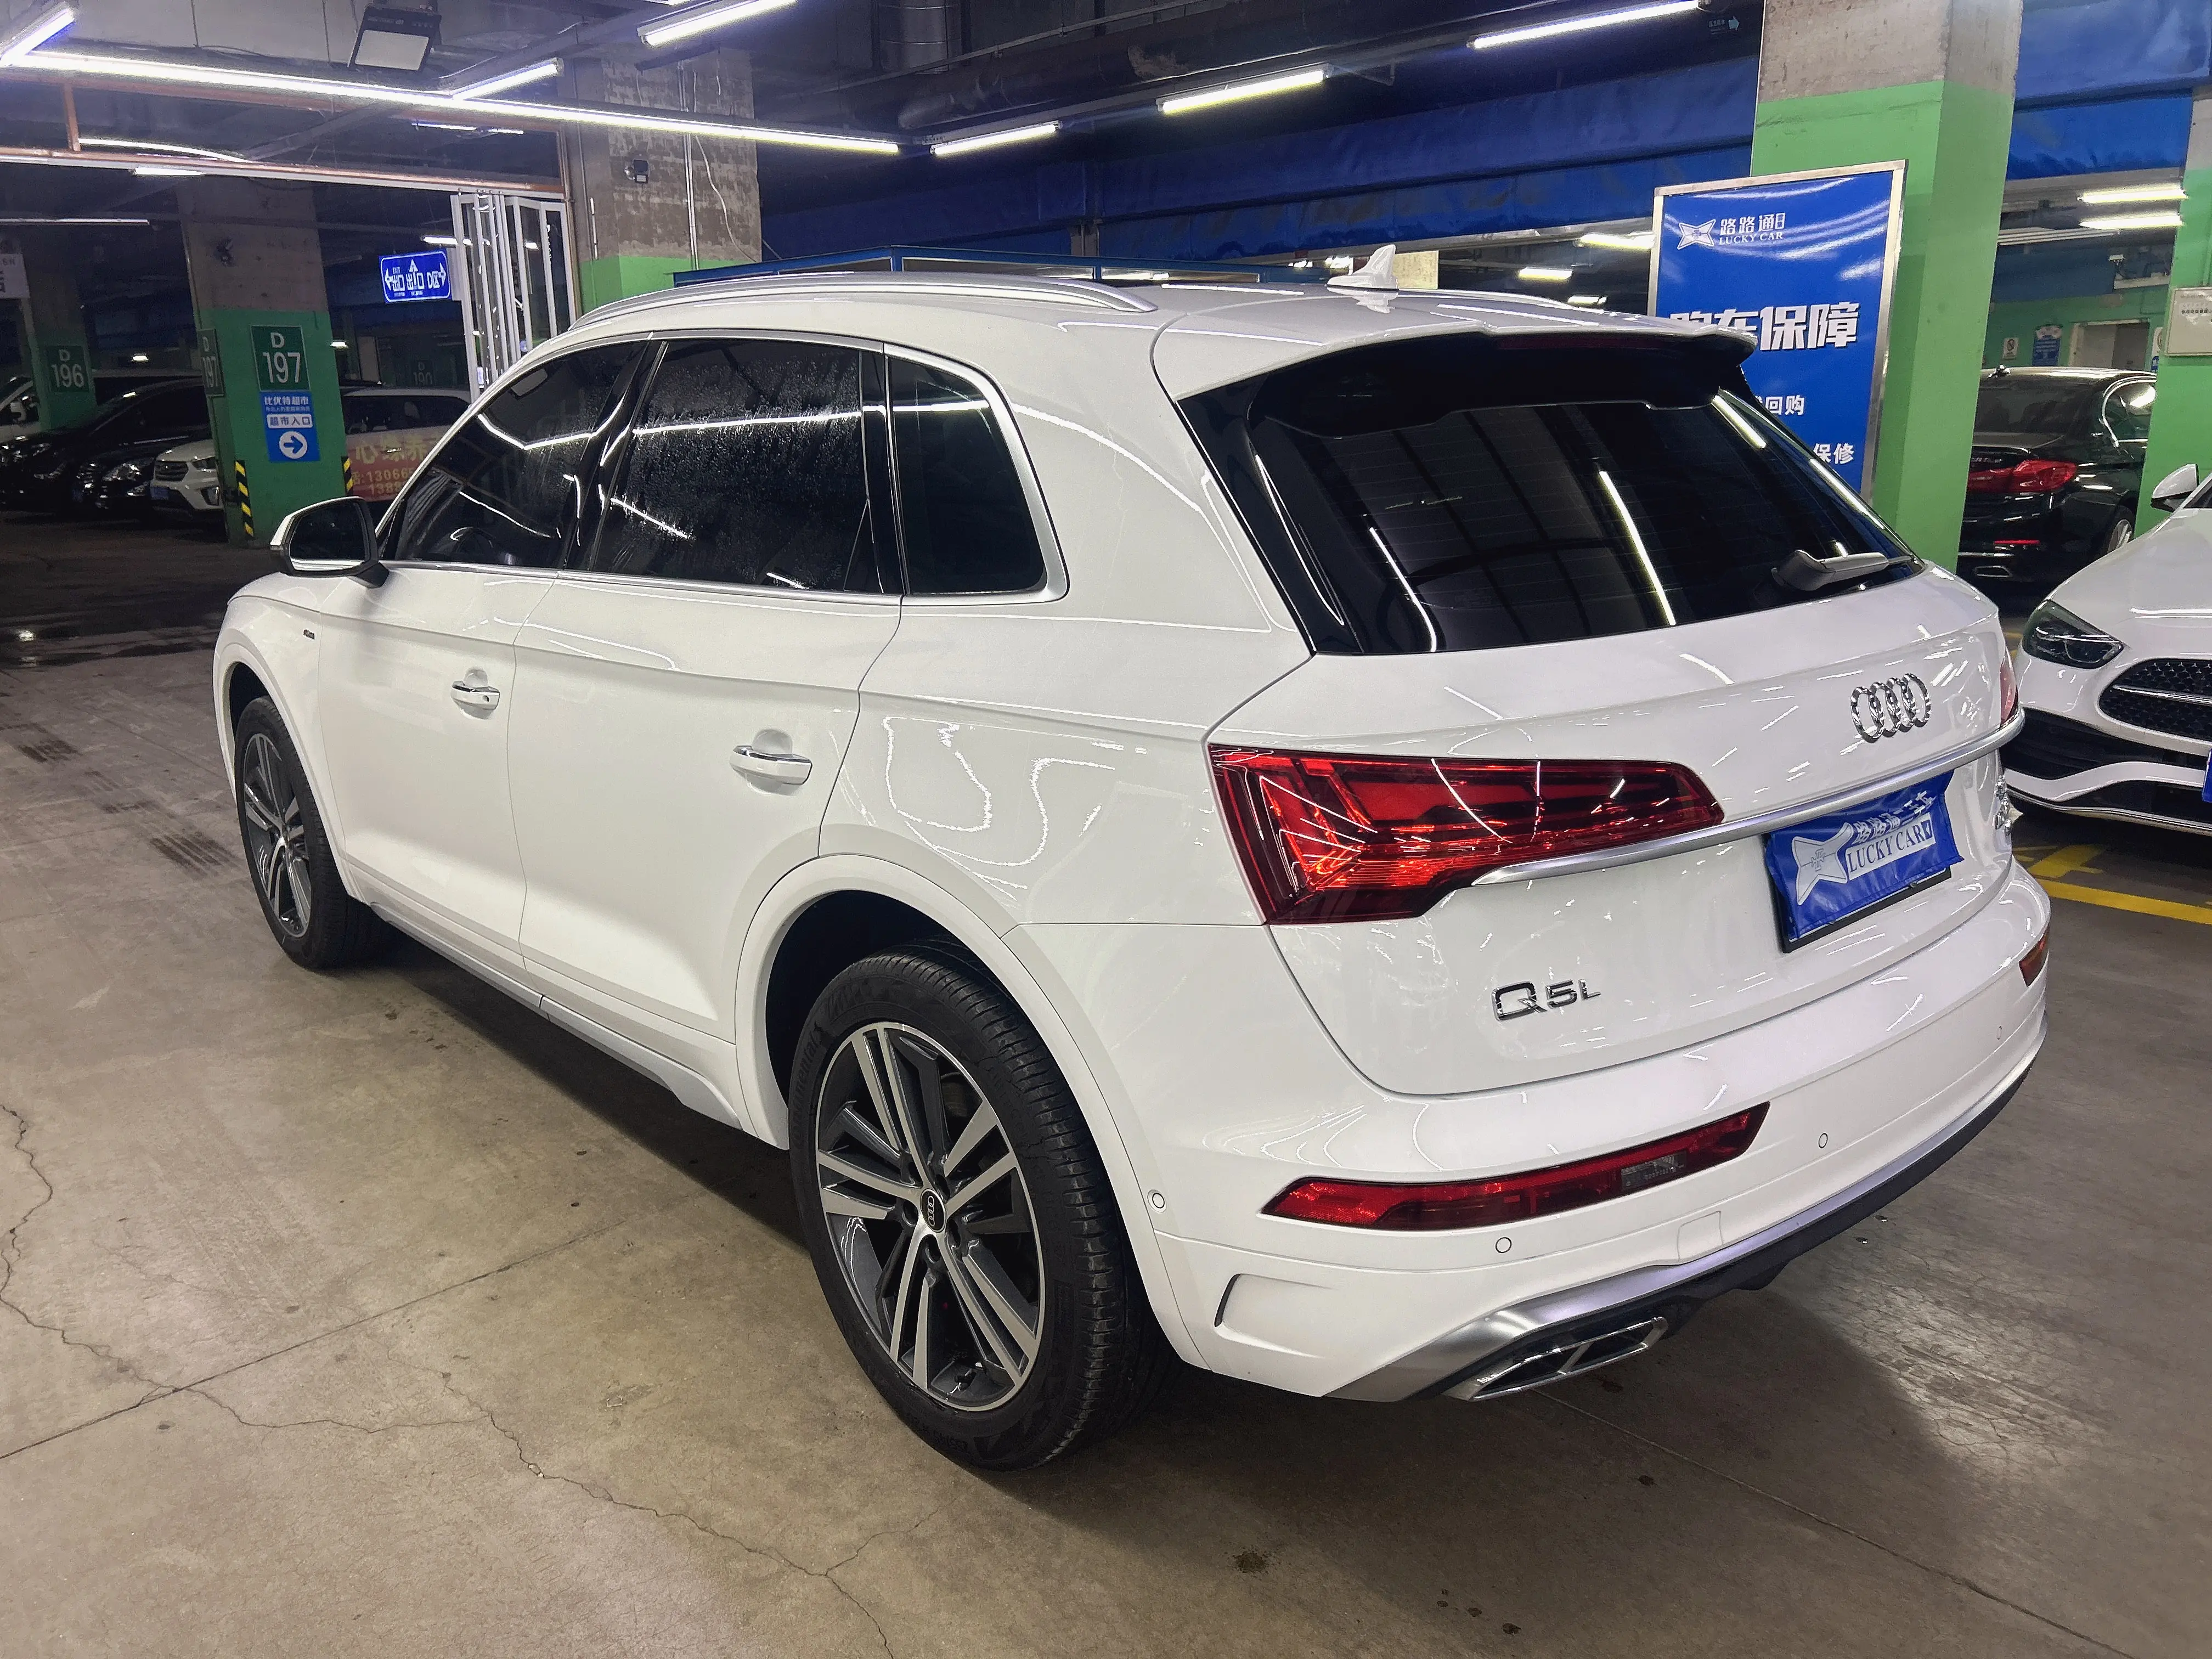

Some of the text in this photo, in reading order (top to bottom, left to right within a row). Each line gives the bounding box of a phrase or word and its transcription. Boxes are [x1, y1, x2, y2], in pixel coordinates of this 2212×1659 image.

[1720, 214, 1774, 235] 路路通
[1719, 232, 1783, 245] LUCKY CAR
[270, 332, 285, 348] D
[58, 349, 70, 362] D
[51, 363, 84, 388] 196
[263, 352, 301, 383] 197
[1756, 394, 1805, 415] 回购
[270, 415, 311, 426] 超市入口
[1813, 442, 1854, 464] 保修
[1847, 834, 1893, 873] LUCKY
[1895, 824, 1925, 851] CAR
[1491, 979, 1601, 1022] Q5L
